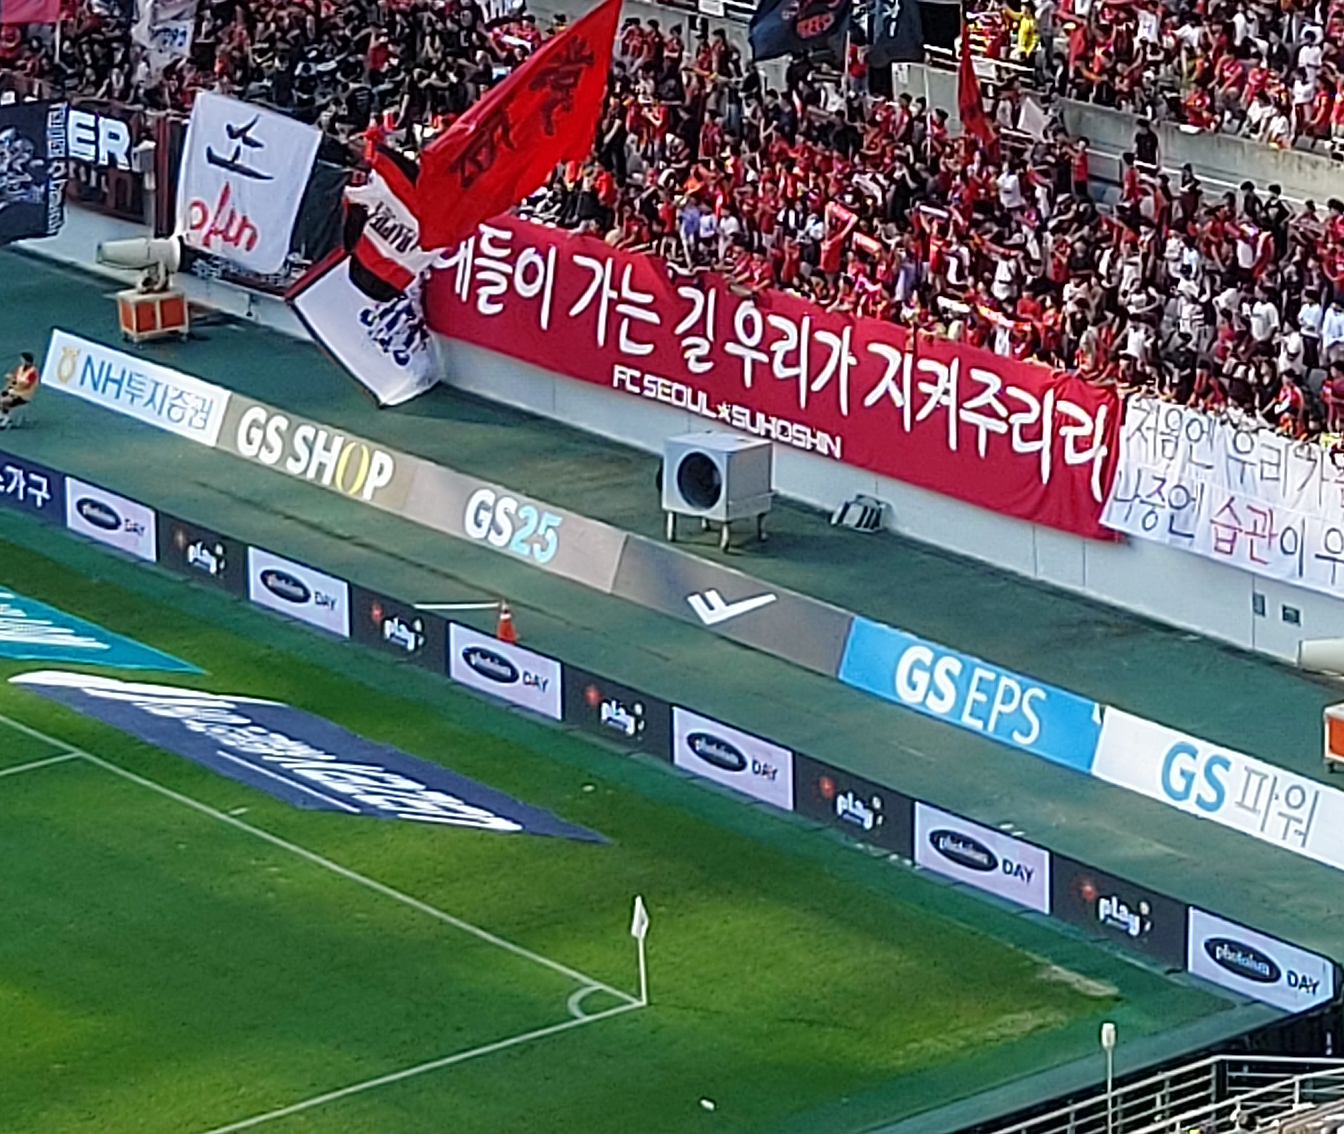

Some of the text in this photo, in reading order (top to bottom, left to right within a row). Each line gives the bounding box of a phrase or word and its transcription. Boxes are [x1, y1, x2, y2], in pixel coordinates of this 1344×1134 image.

[569, 253, 661, 356] 가는
[674, 285, 718, 374] 길
[723, 300, 858, 417] 우리가
[863, 341, 1110, 504] 지켜주리라
[612, 364, 843, 462] FC SEOUL SUHOSHIN
[237, 405, 395, 503] GS SHOP
[1225, 428, 1330, 509] 우리가
[463, 487, 564, 564] GS25
[1112, 467, 1206, 539] 나중엔
[1209, 495, 1307, 580] 습관이
[522, 671, 550, 694] DAY
[895, 644, 1048, 745] GS EPS
[751, 758, 779, 782] DAY
[1160, 740, 1320, 849] GS 파워
[1001, 858, 1036, 884] DAY
[1286, 969, 1321, 996] DAY
